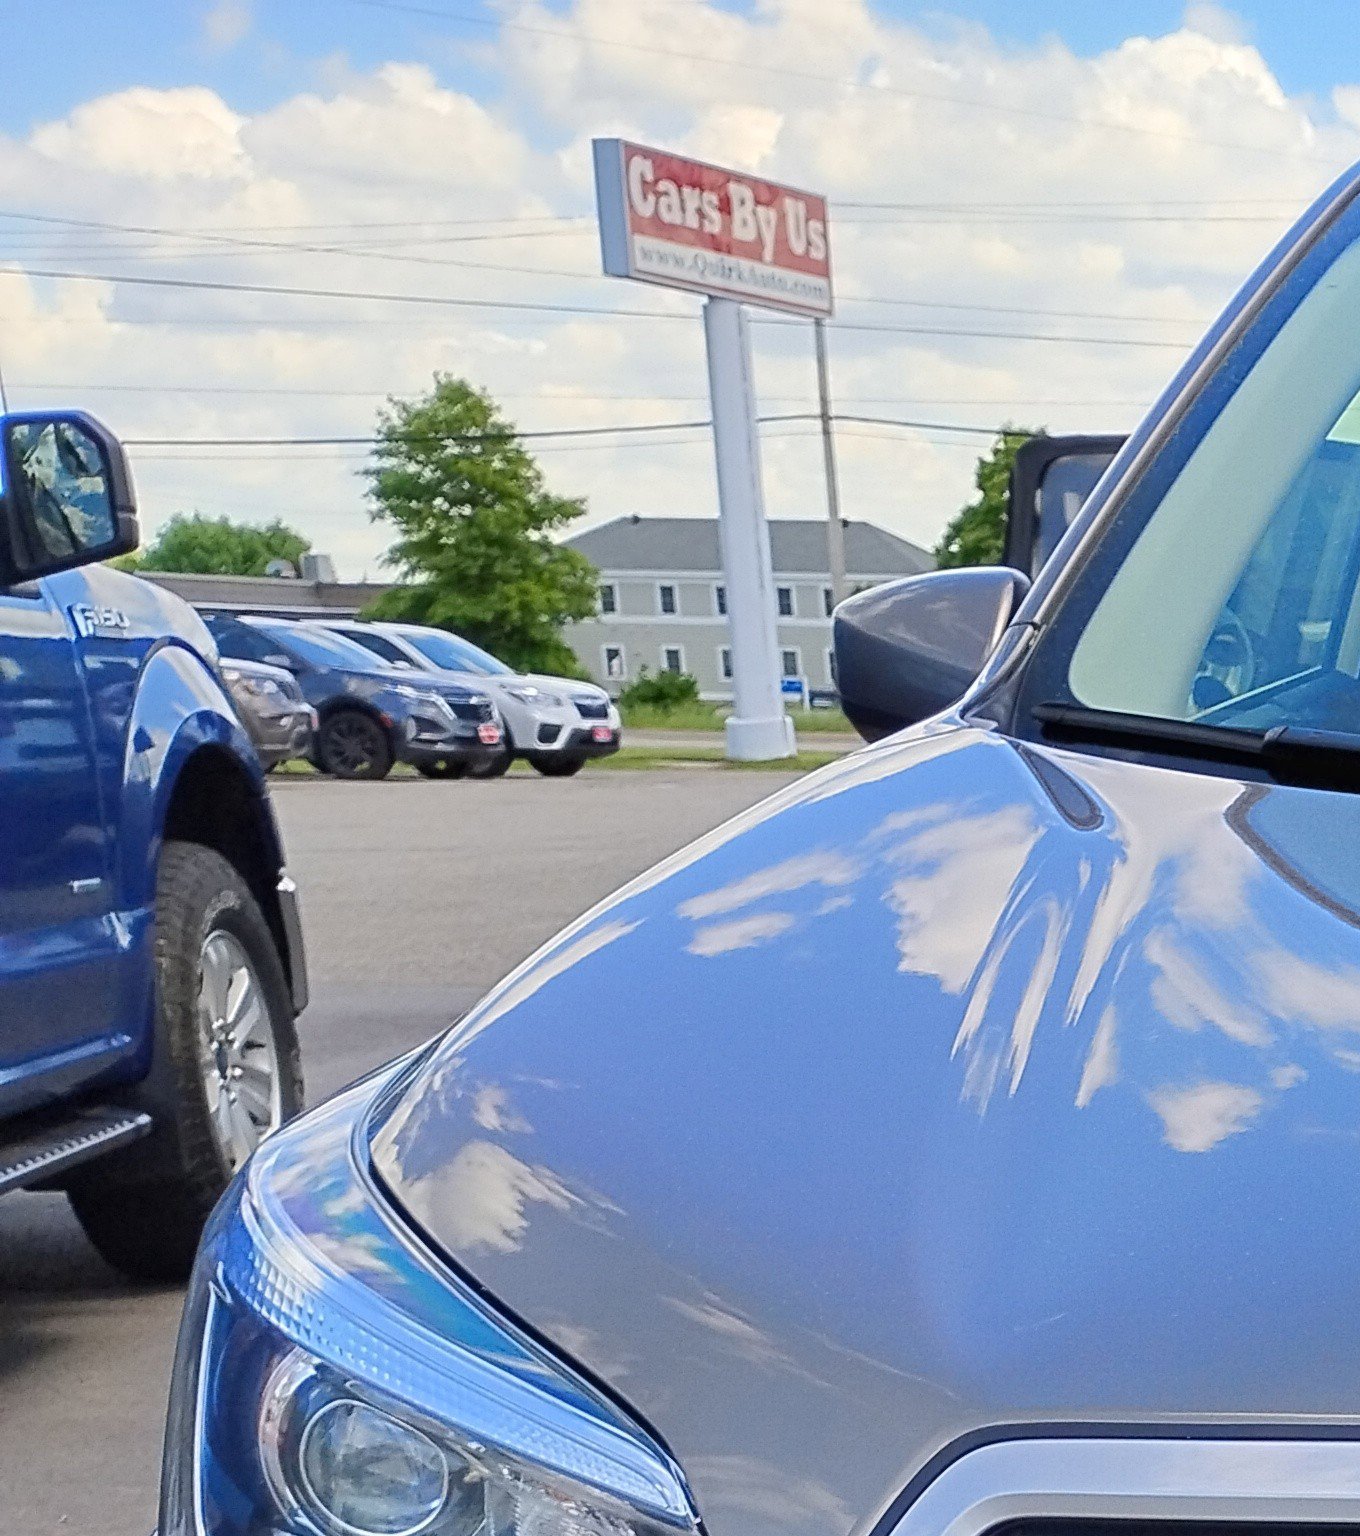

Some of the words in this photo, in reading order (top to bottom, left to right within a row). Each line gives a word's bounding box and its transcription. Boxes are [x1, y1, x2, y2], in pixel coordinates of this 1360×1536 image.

[628, 155, 721, 235] Cars
[727, 180, 776, 264] By
[785, 197, 826, 261] Us
